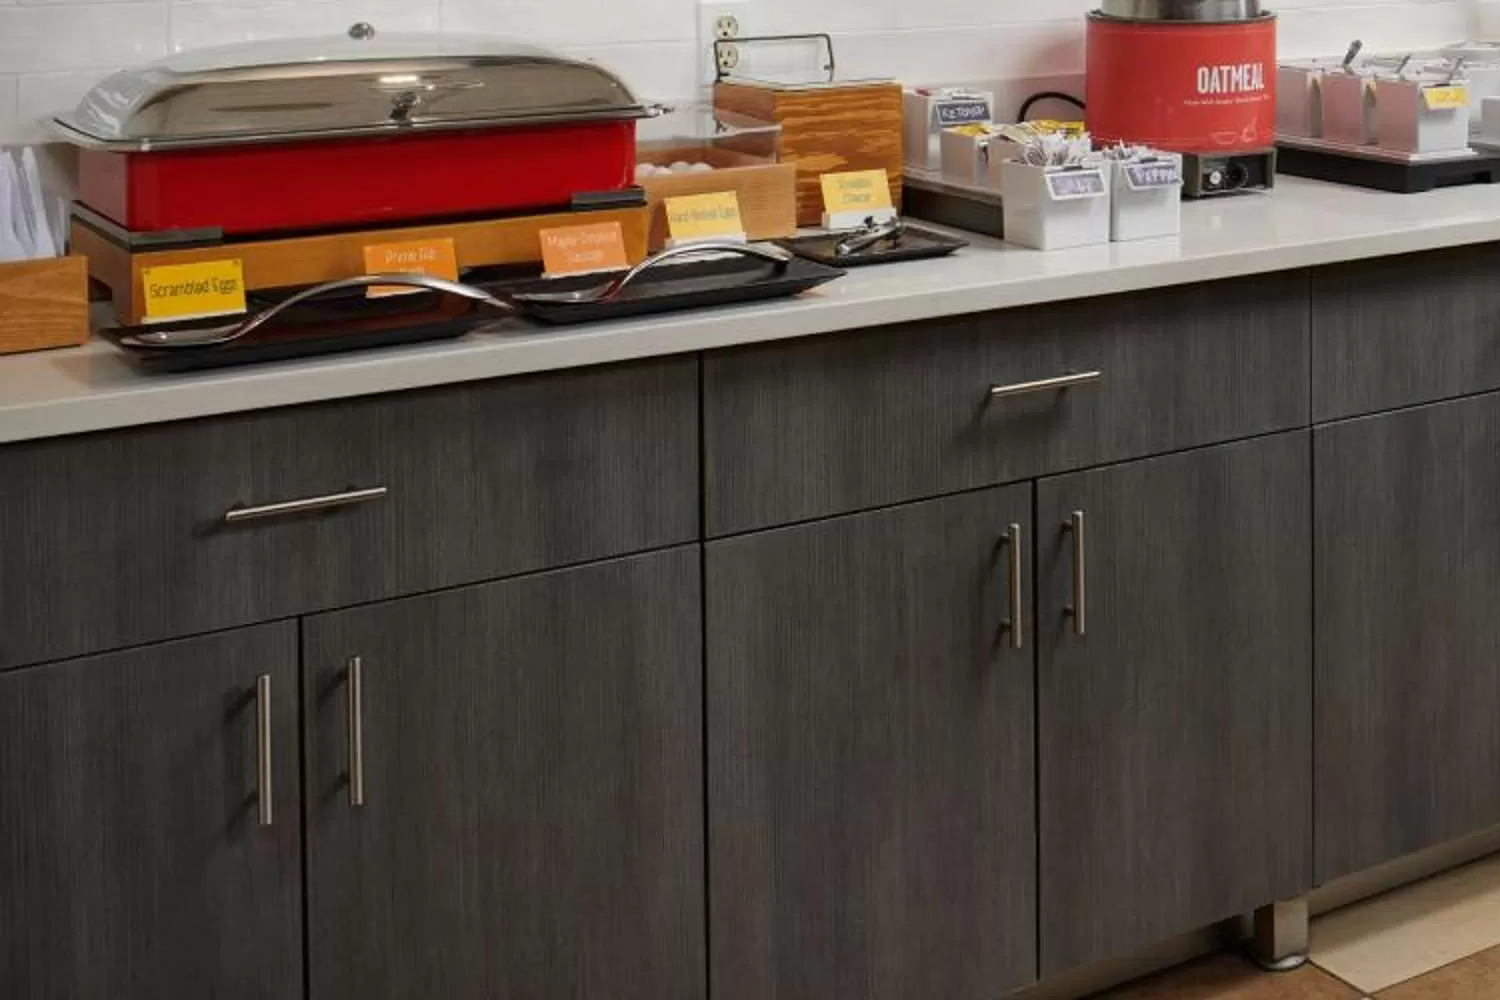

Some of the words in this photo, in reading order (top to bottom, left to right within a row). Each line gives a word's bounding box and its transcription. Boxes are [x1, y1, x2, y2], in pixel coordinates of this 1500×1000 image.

[1196, 63, 1265, 95] OATMEAL
[149, 279, 209, 298] Scrambled
[211, 276, 237, 295] Eggs
